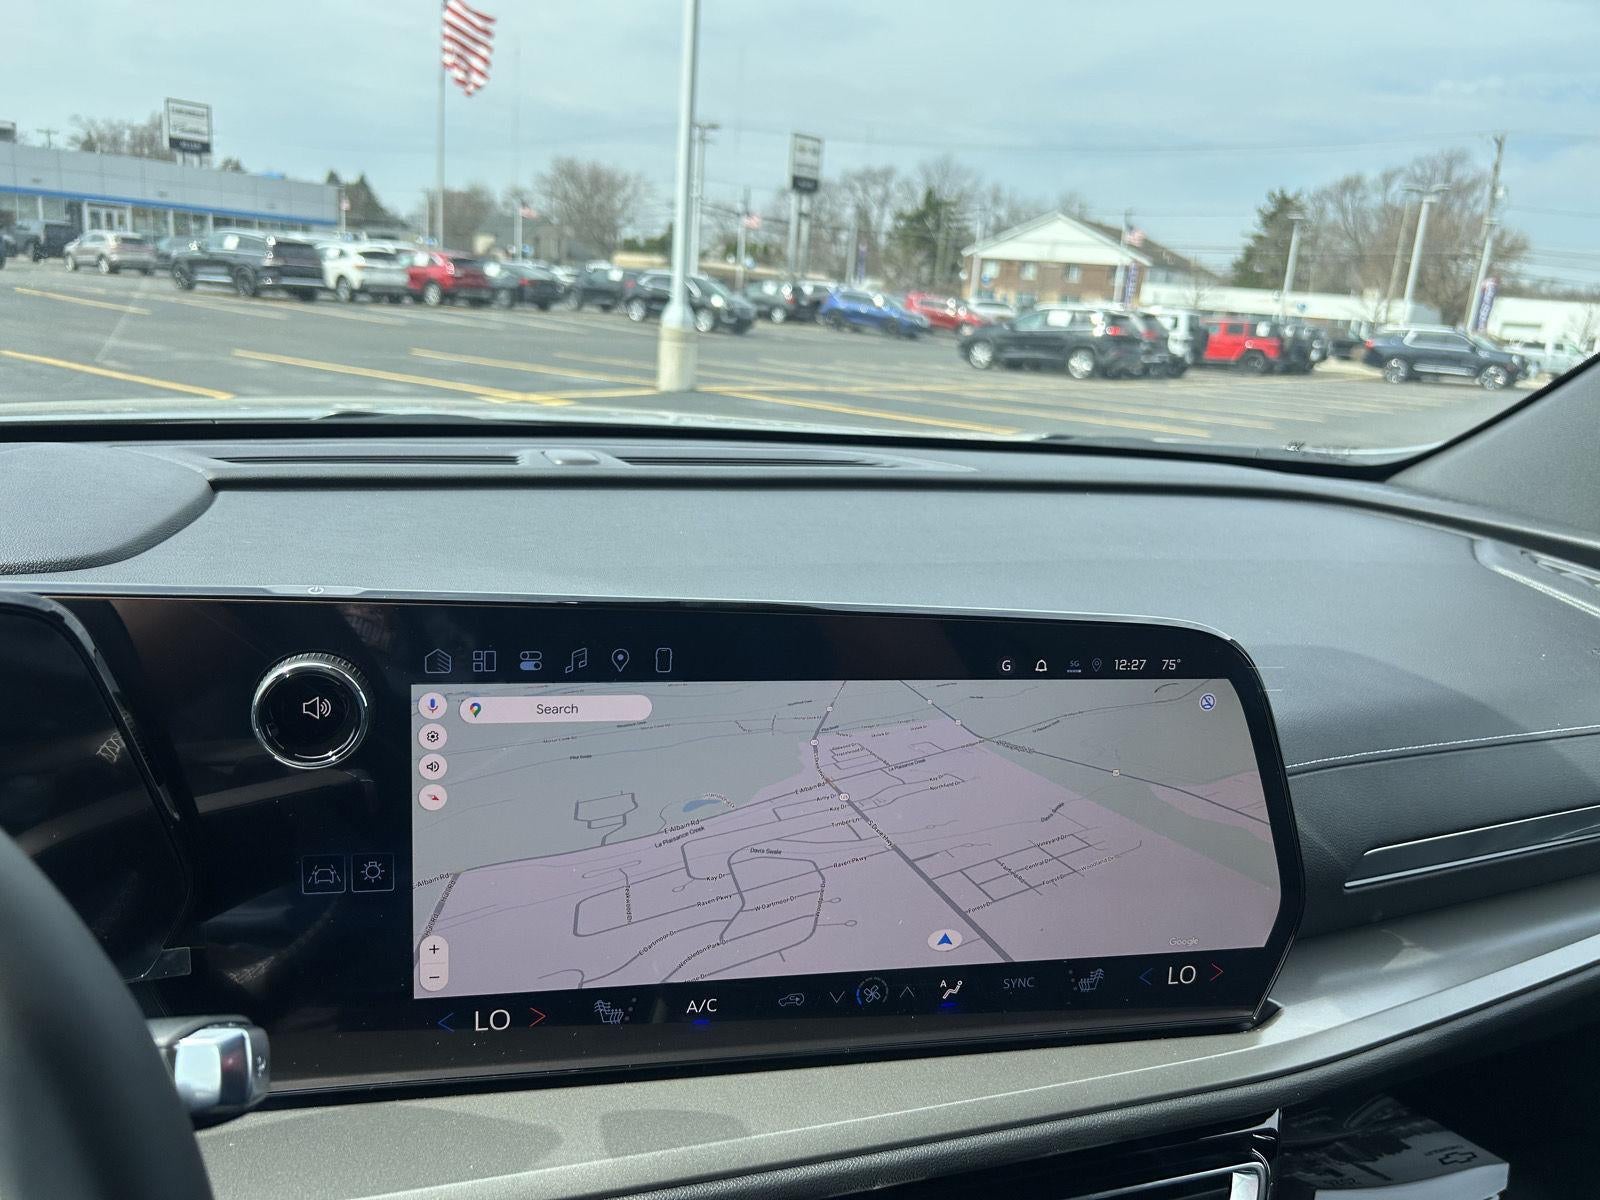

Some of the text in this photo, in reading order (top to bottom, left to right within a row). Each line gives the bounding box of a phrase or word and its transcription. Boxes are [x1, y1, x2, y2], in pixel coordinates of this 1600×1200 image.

[1001, 660, 1011, 671] G
[1114, 659, 1147, 671] 12:27
[1161, 658, 1181, 671] 75°
[536, 703, 579, 715] Search
[669, 821, 690, 832] Albain
[832, 819, 850, 827] Timber
[662, 832, 690, 846] Plaisance
[689, 826, 705, 835] Creek
[882, 834, 894, 847] Hwy
[833, 856, 868, 869] Raven Pkwy
[1024, 861, 1044, 871] Central
[417, 876, 439, 888] Albain
[1042, 876, 1059, 886] Forest
[696, 894, 732, 907] Raven Pkwy
[762, 898, 789, 910] Dartmoor
[967, 903, 986, 914] Forest
[643, 933, 669, 953] Dartmoor
[1169, 937, 1199, 947] Google
[679, 947, 706, 969] Wimbledon
[706, 942, 720, 951] Park
[1168, 965, 1197, 985] LO
[940, 980, 947, 988] A
[1003, 977, 1035, 989] SYNC
[686, 999, 718, 1014] A/C
[475, 1009, 511, 1032] LO
